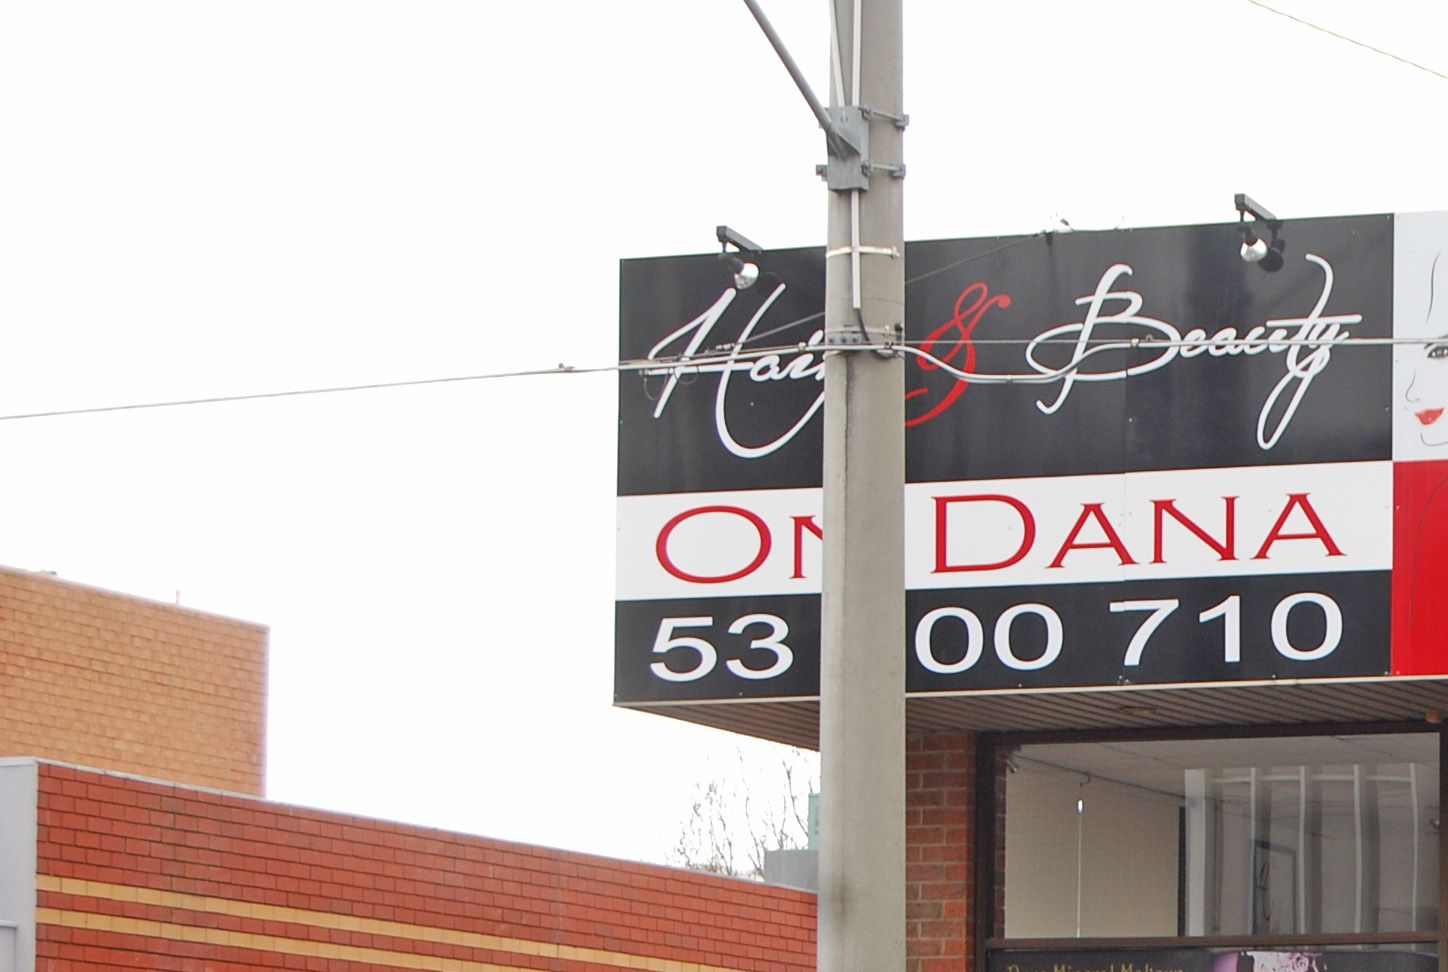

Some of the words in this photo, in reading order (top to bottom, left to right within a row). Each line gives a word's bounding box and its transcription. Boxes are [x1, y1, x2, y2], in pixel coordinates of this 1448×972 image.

[644, 283, 824, 458] Hai
[1026, 254, 1363, 450] Beauty
[930, 492, 1347, 575] DANA
[650, 613, 794, 682] 53
[913, 603, 1064, 674] 00
[1109, 592, 1344, 667] 710
